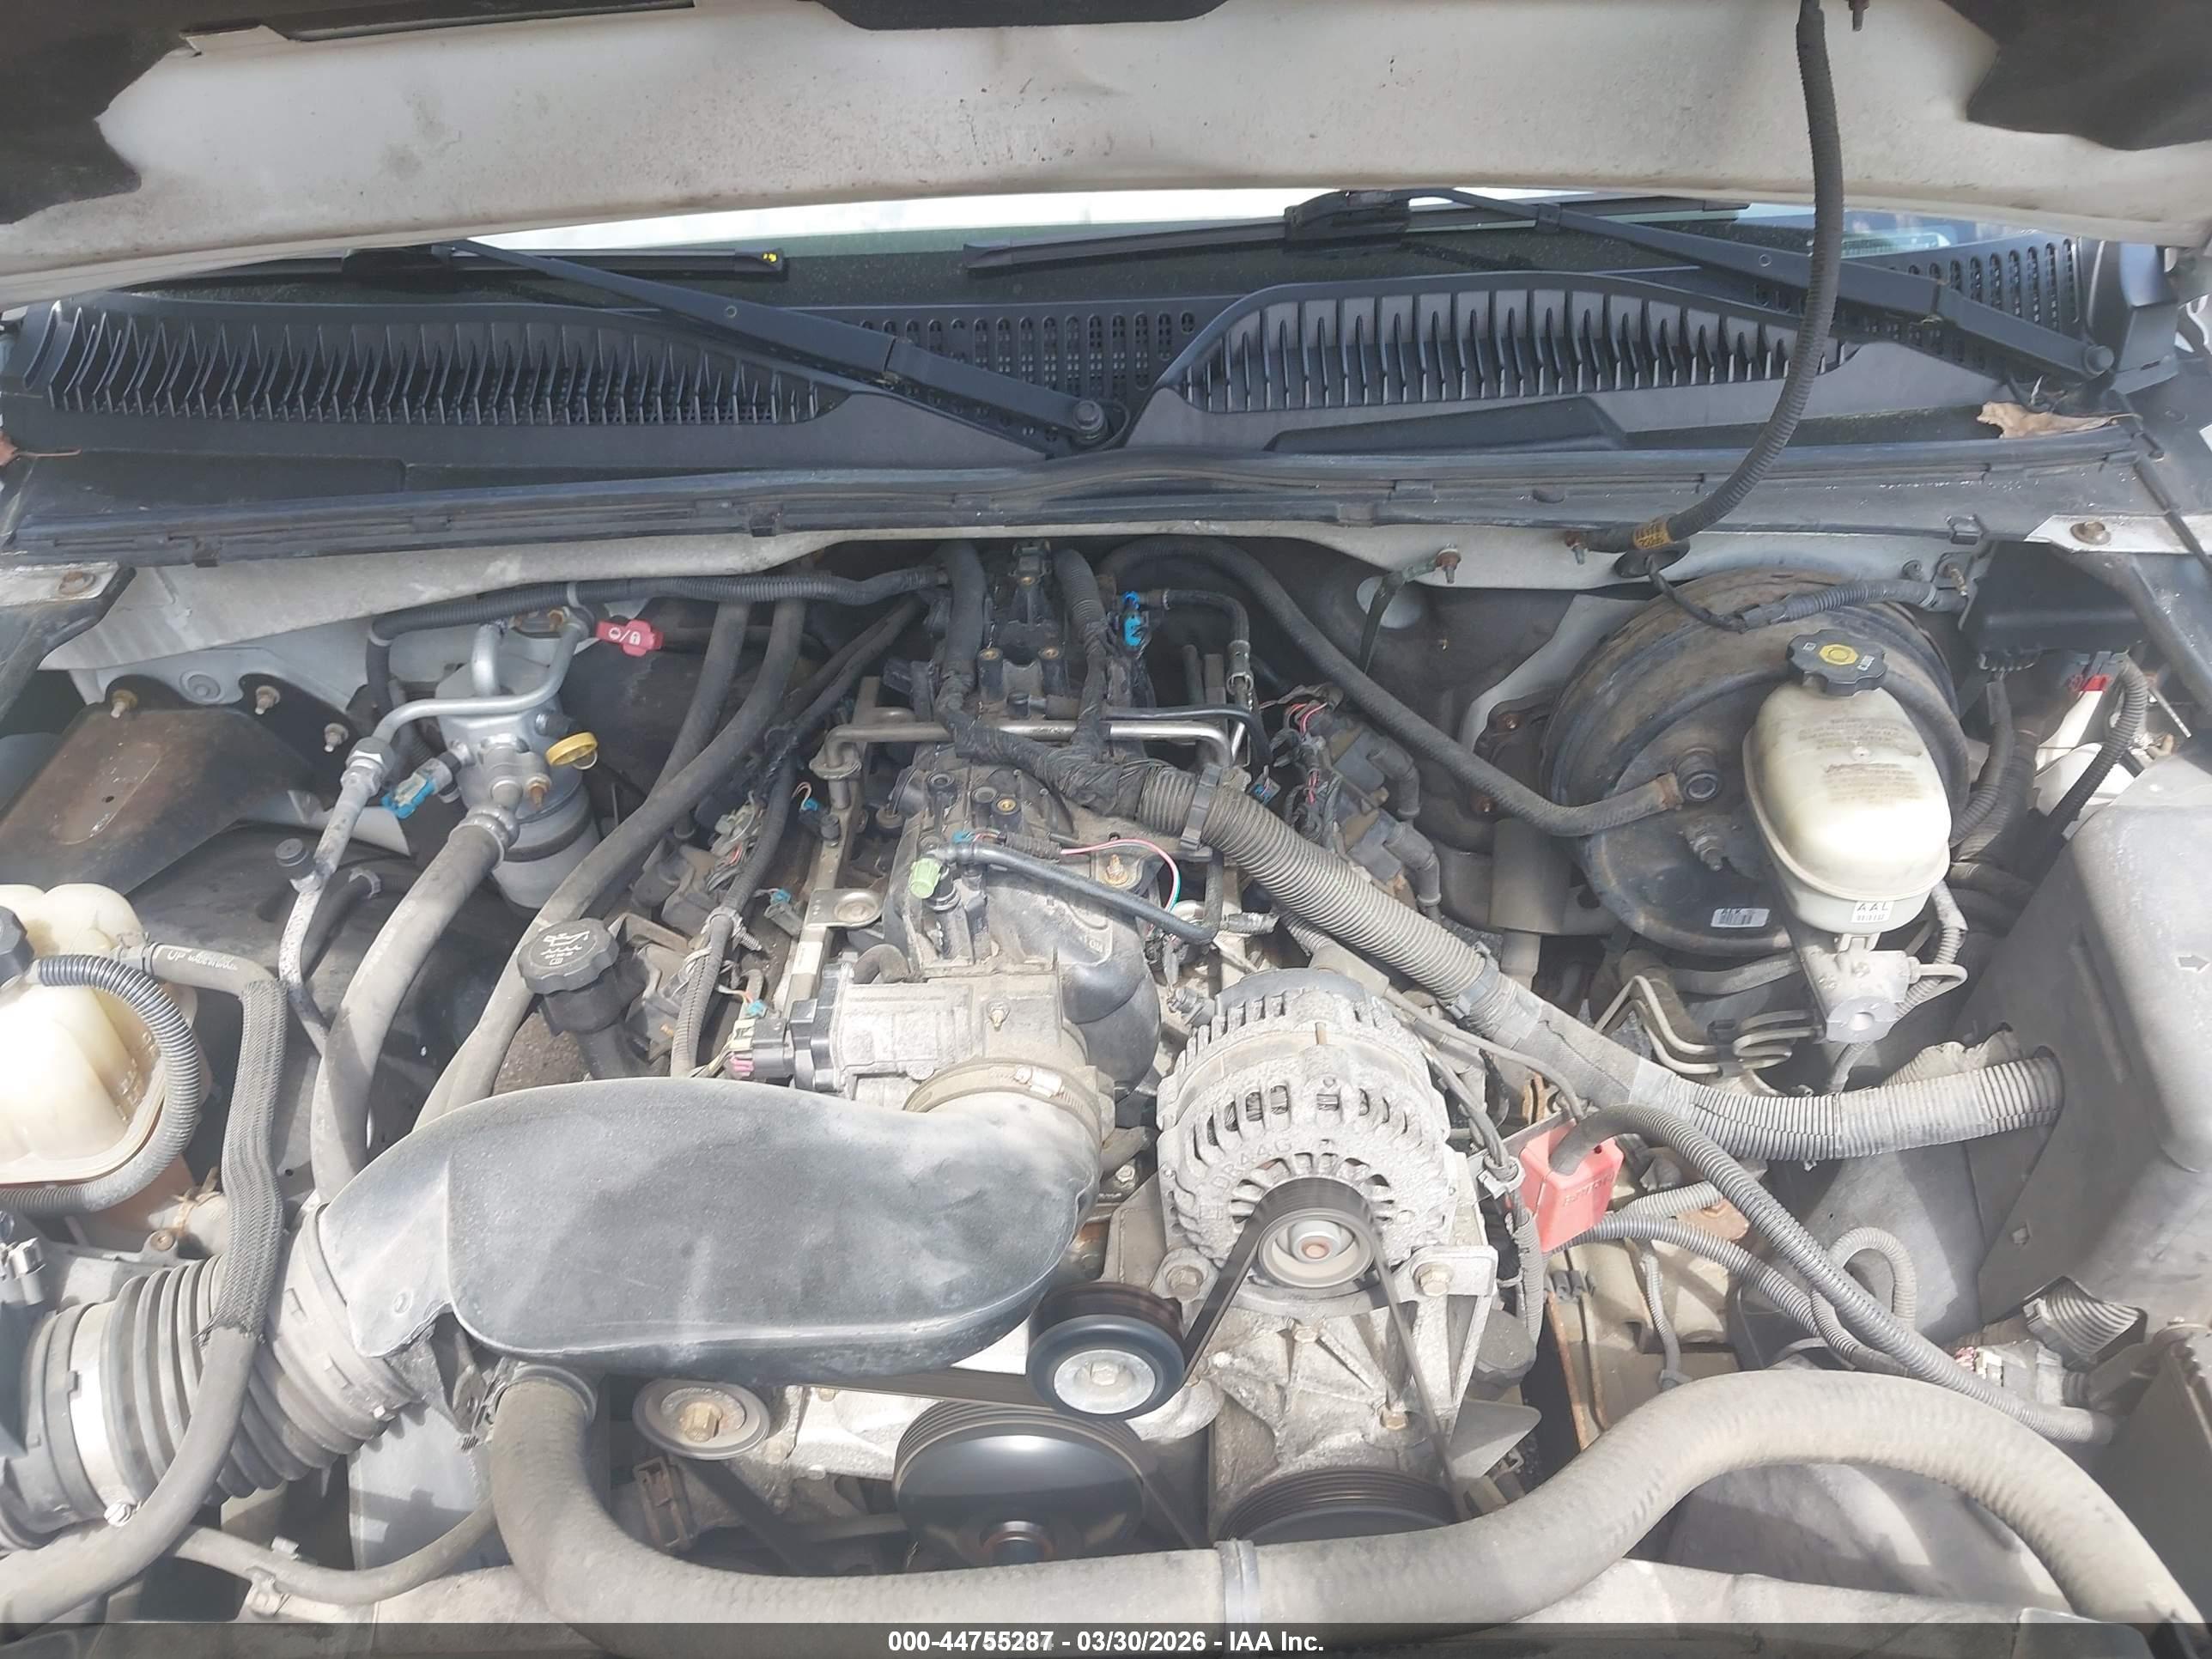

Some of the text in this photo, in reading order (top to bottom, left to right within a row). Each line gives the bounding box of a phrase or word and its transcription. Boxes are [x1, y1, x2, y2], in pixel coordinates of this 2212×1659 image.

[1856, 901, 1889, 912] AAL
[167, 949, 186, 962] UP
[1211, 1138, 1292, 1190] DR44G
